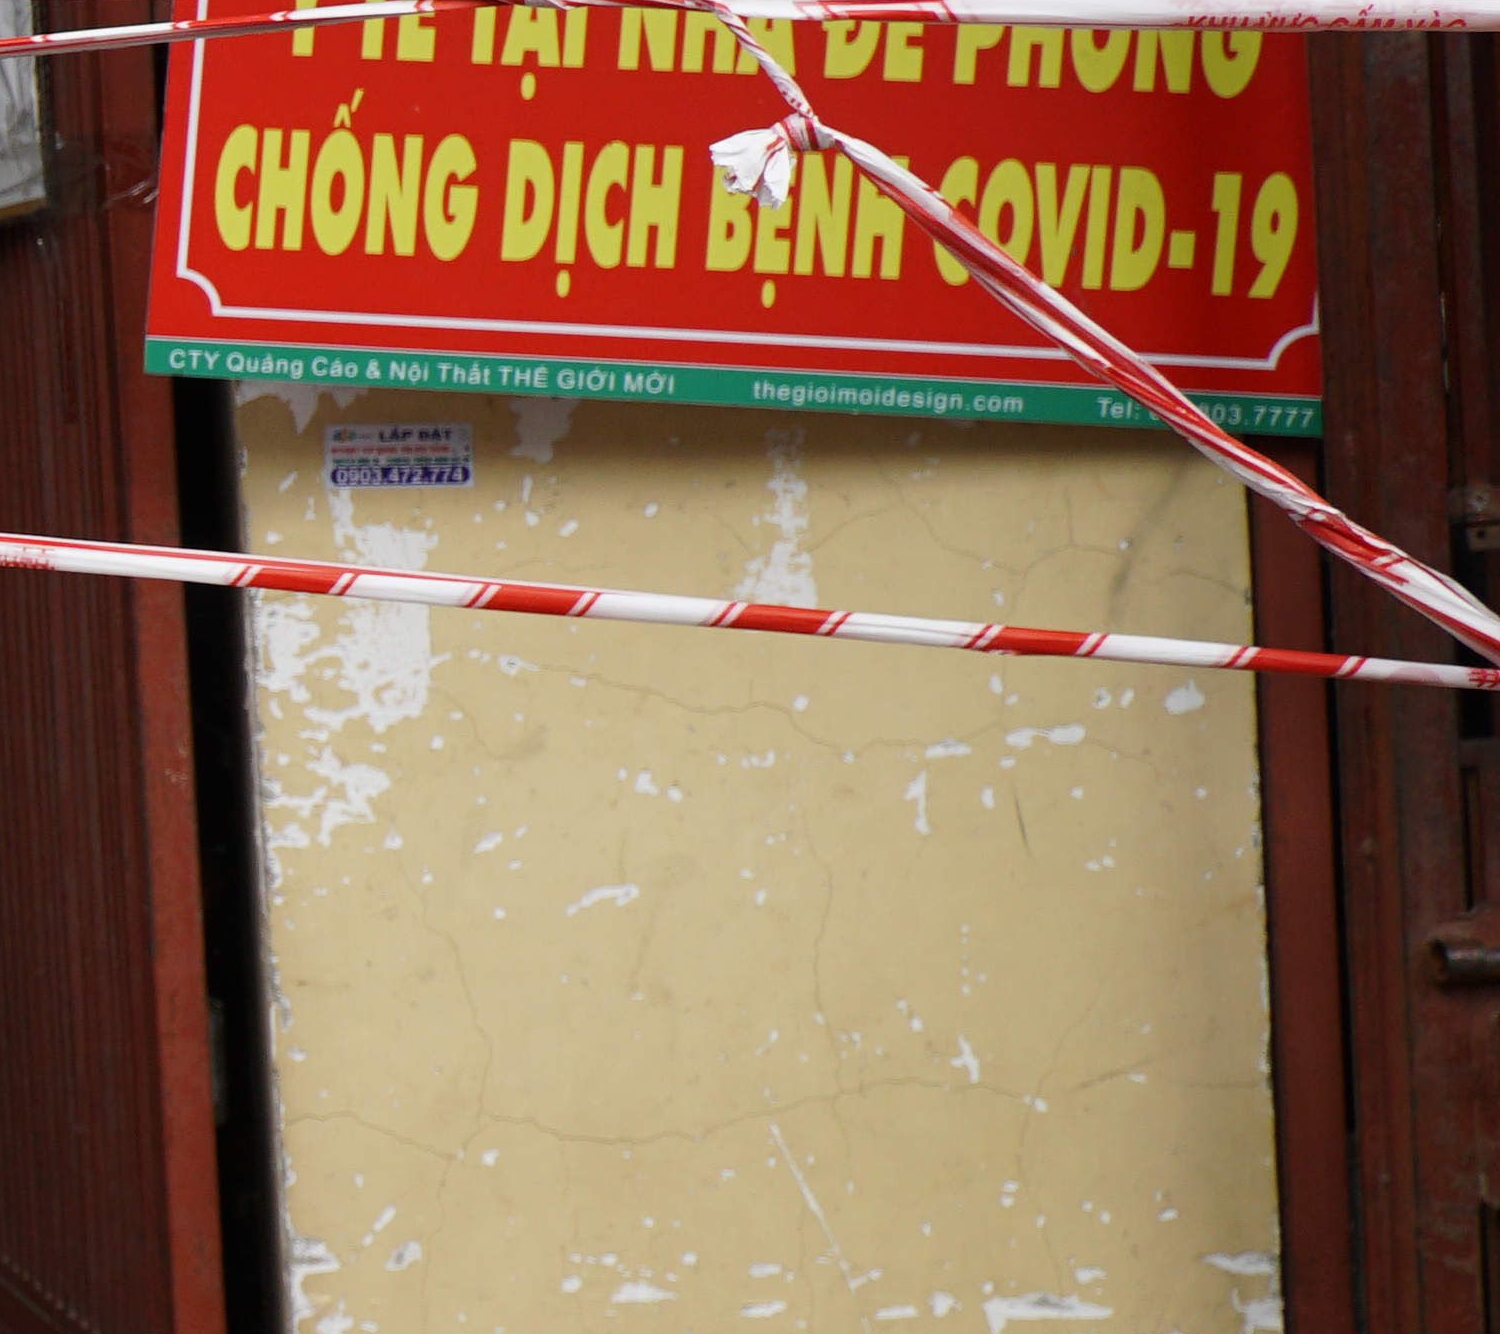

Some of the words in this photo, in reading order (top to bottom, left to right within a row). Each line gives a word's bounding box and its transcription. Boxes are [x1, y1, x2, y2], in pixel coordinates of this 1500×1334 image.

[214, 88, 479, 263] CHỐNG
[501, 139, 685, 298] DỊCH
[934, 156, 1298, 299] COVID-19
[169, 349, 219, 370] CTY
[226, 351, 303, 380] Quảng
[311, 355, 359, 379] Cáo
[366, 360, 382, 379] &
[389, 358, 429, 385] Nội
[556, 366, 615, 393] GIỚI
[624, 369, 675, 395] MỚI
[752, 380, 1024, 415] thegioimoidesign.com
[1096, 397, 1139, 420] Tel:
